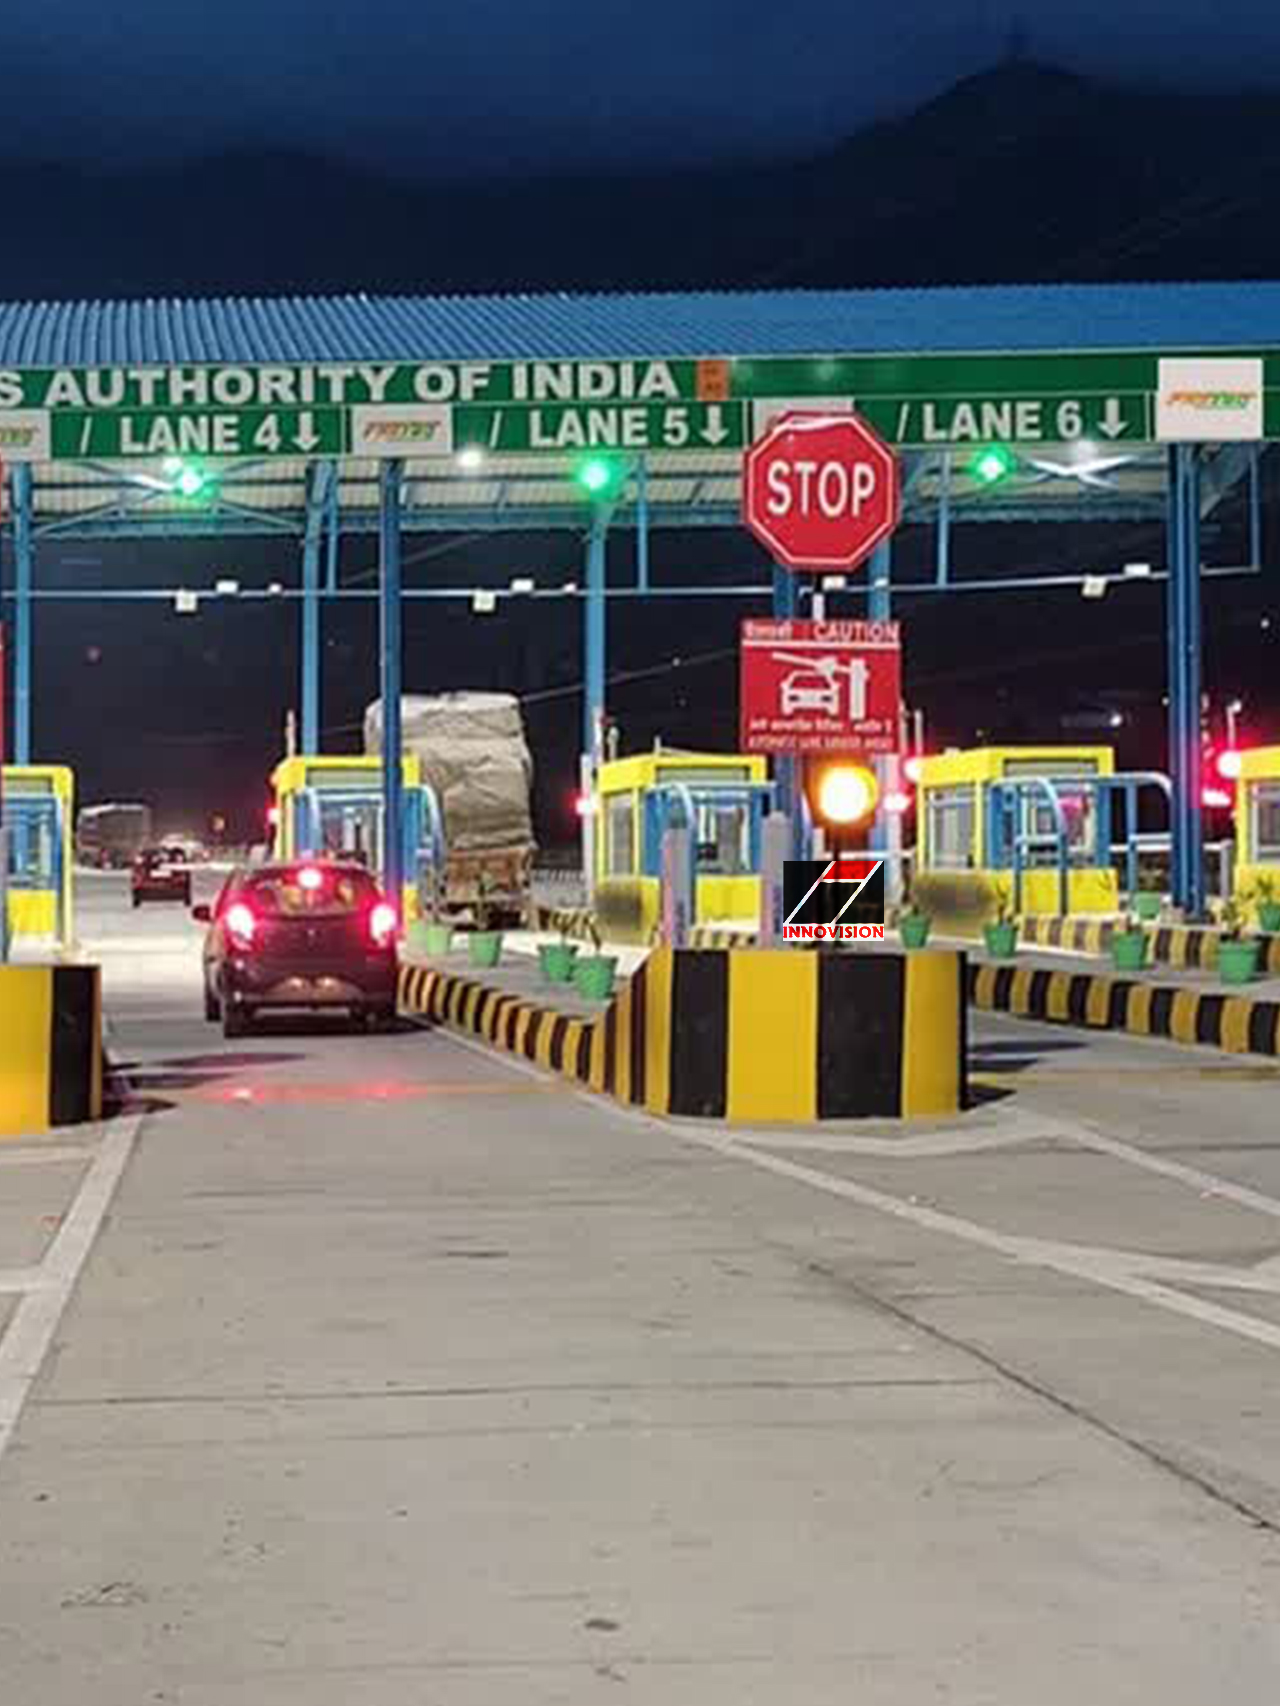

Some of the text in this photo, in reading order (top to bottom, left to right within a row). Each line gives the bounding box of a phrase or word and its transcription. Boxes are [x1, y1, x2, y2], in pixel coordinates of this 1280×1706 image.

[44, 366, 396, 407] AUTHORITY
[414, 366, 491, 401] OF
[513, 362, 680, 400] INDIA
[120, 414, 240, 454] LANE
[253, 413, 282, 452] 4
[529, 407, 649, 448] LANE
[663, 407, 690, 446] 5
[922, 401, 1042, 441] LANE
[1056, 400, 1082, 440] 6
[767, 458, 876, 517] STOP
[813, 620, 900, 642] CAUTION
